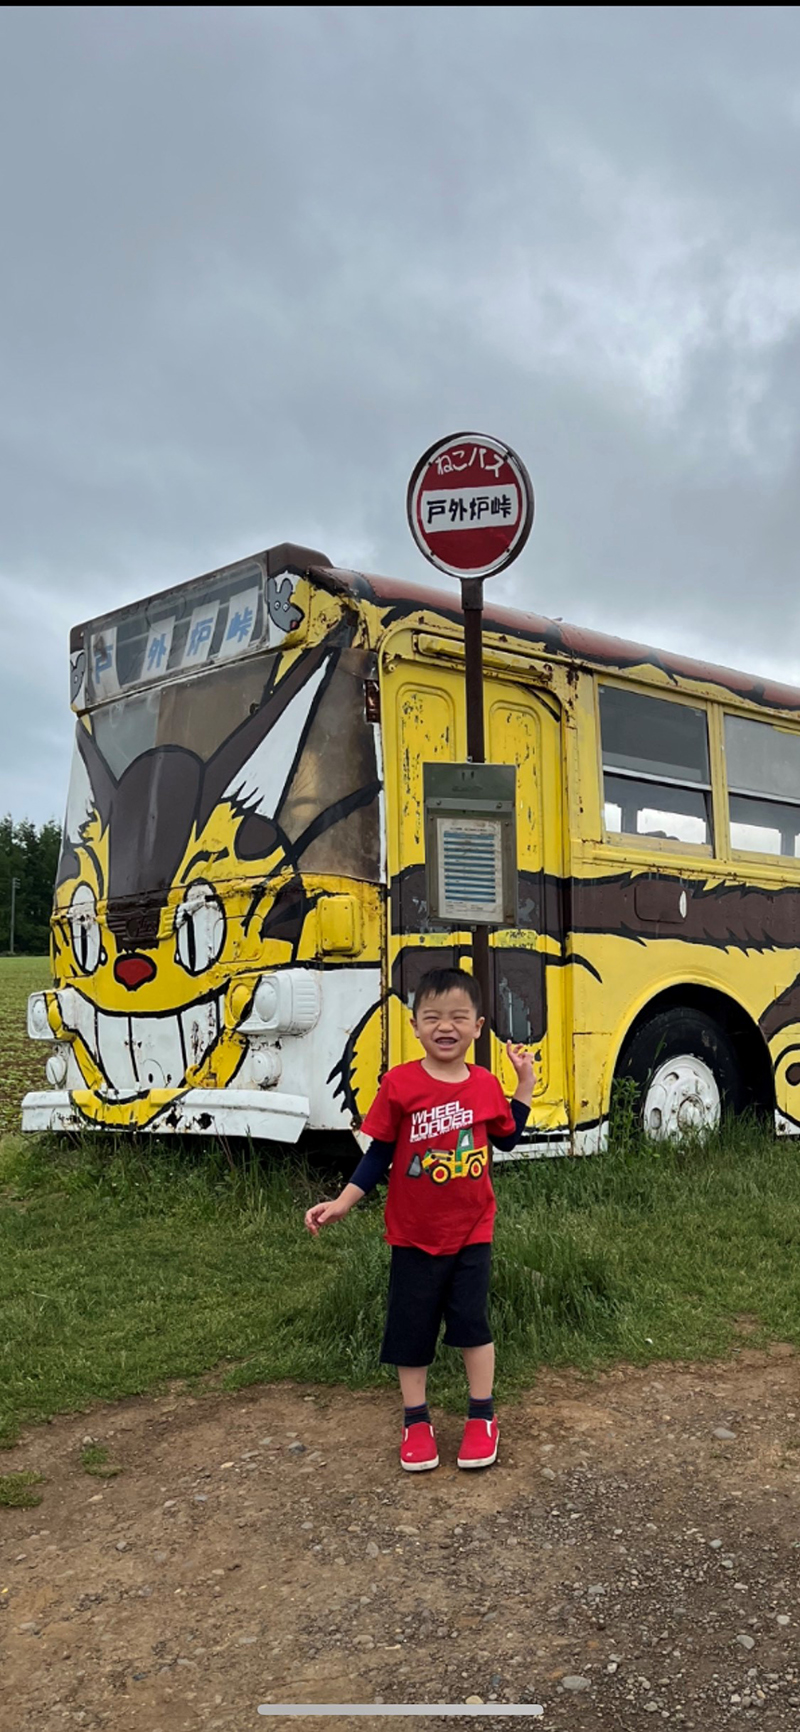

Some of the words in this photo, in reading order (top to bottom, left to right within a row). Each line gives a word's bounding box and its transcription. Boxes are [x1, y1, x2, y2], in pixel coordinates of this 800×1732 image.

[426, 494, 512, 524] 戸外炉峠
[410, 1109, 473, 1139] LOADER
[411, 1100, 464, 1125] WHEEL
